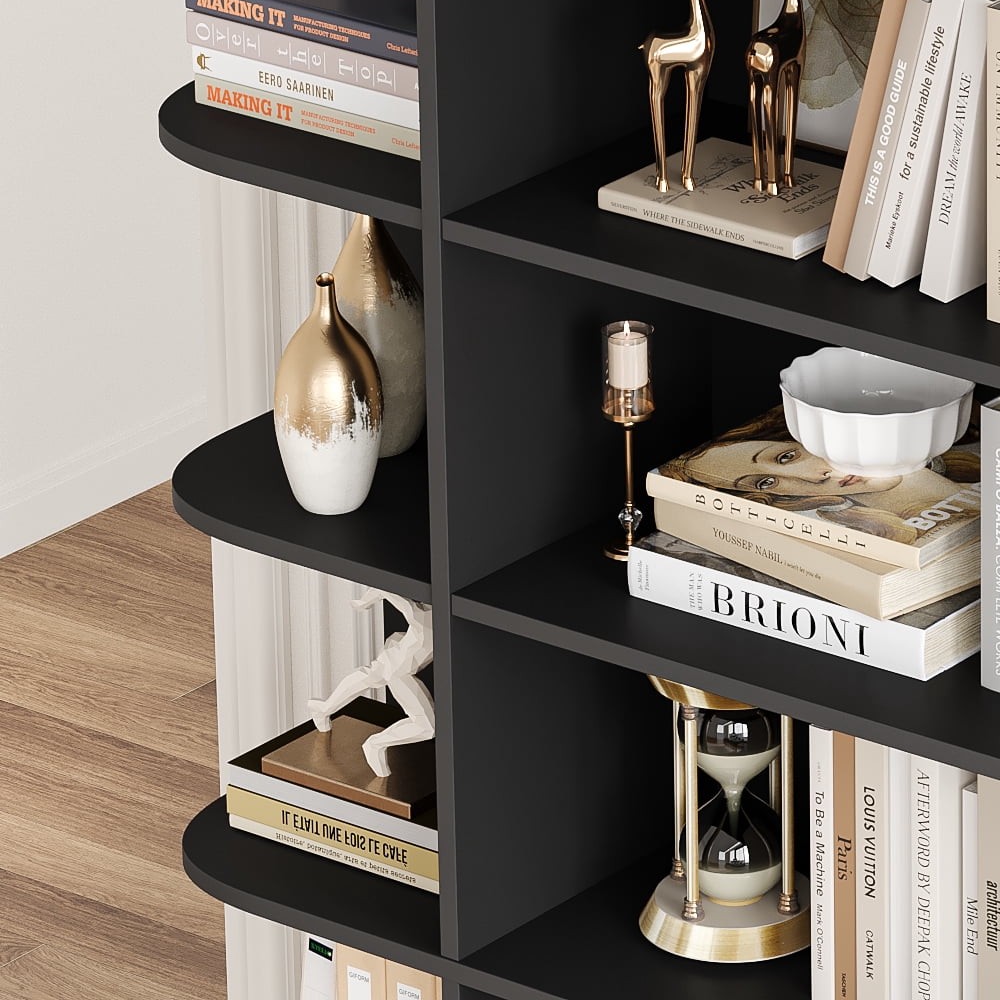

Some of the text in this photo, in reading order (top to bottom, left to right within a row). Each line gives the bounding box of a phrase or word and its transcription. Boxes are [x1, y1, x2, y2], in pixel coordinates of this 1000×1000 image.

[268, 7, 286, 28] IT
[206, 85, 293, 121] MAKING IT
[259, 71, 335, 101] EERO SAARINEN
[900, 26, 945, 181] for a sustainable lifestyle
[865, 58, 907, 206] THIS IS A GOOD GUIDE
[939, 72, 973, 226] DREAM the world AWAKE
[642, 208, 745, 243] WHERE THE SIDEWALK ENDS
[712, 527, 783, 564] YOUSSEF NABIL
[711, 581, 870, 657] BRIONI
[815, 792, 824, 805] To
[815, 809, 824, 826] Be
[916, 768, 930, 868] AFTERWORD
[816, 830, 823, 838] a
[837, 834, 852, 880] Paris
[863, 786, 876, 898] LOUIS VUITTON
[816, 842, 825, 896] Machine
[917, 871, 931, 895] BY
[917, 897, 931, 957] DEEPAK
[966, 896, 979, 956] Mile End
[986, 880, 1000, 951] architectuur
[866, 930, 874, 980] CATWALK
